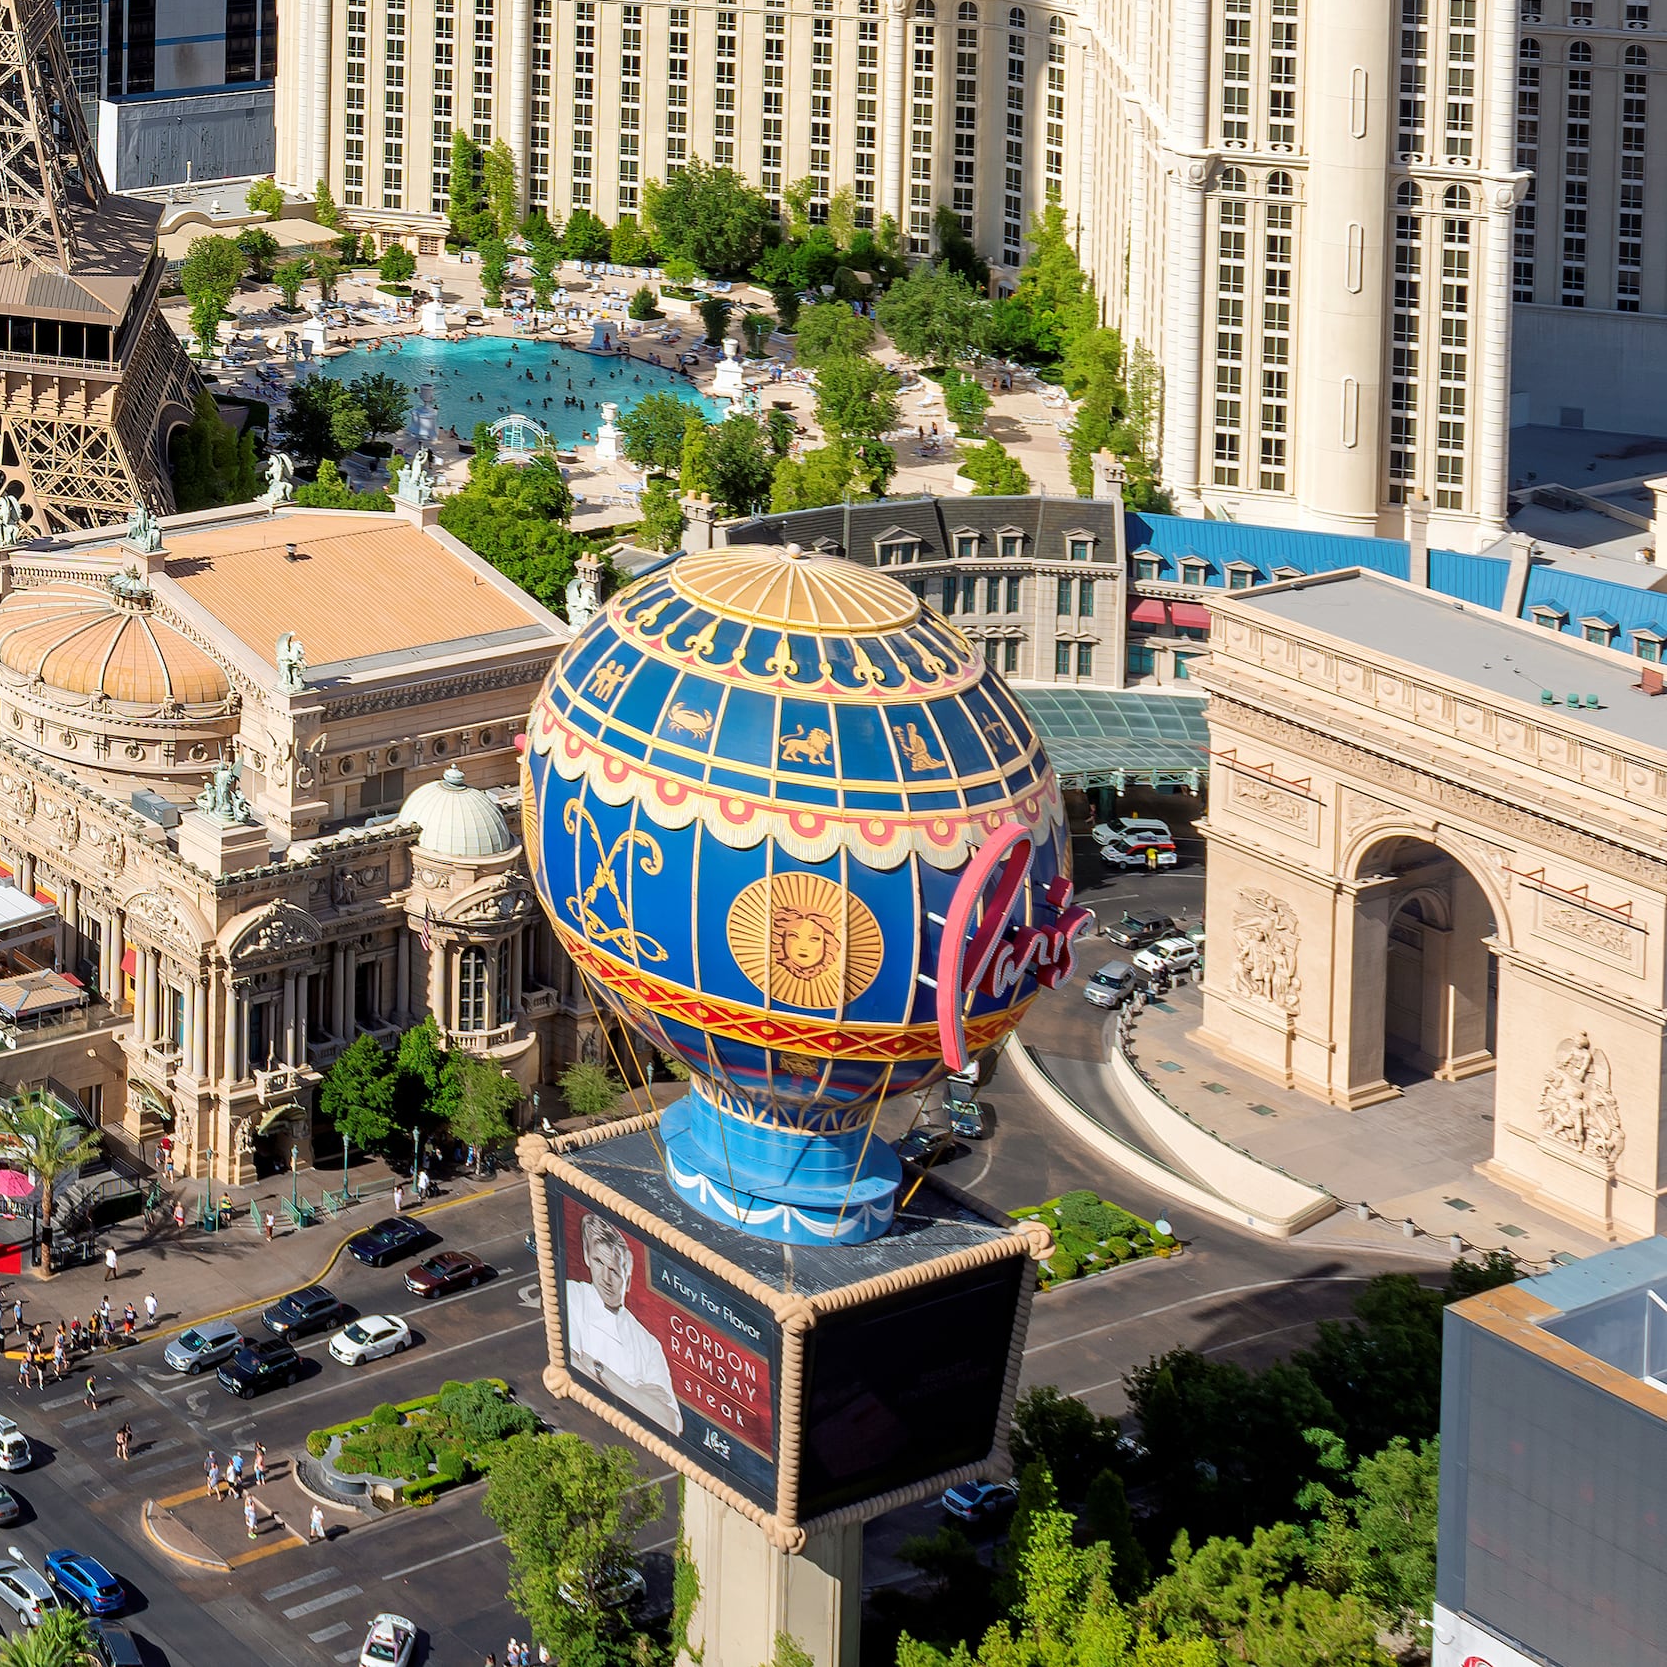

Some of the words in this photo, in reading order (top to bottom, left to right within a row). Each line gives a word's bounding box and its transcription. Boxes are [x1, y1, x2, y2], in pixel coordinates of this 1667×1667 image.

[661, 1269, 672, 1283] A
[673, 1276, 697, 1302] Fury
[701, 1293, 720, 1314] For
[723, 1307, 761, 1341] Flavor
[670, 1315, 757, 1383] GORDON
[670, 1335, 758, 1402] RAMSAY
[684, 1379, 745, 1427] steak
